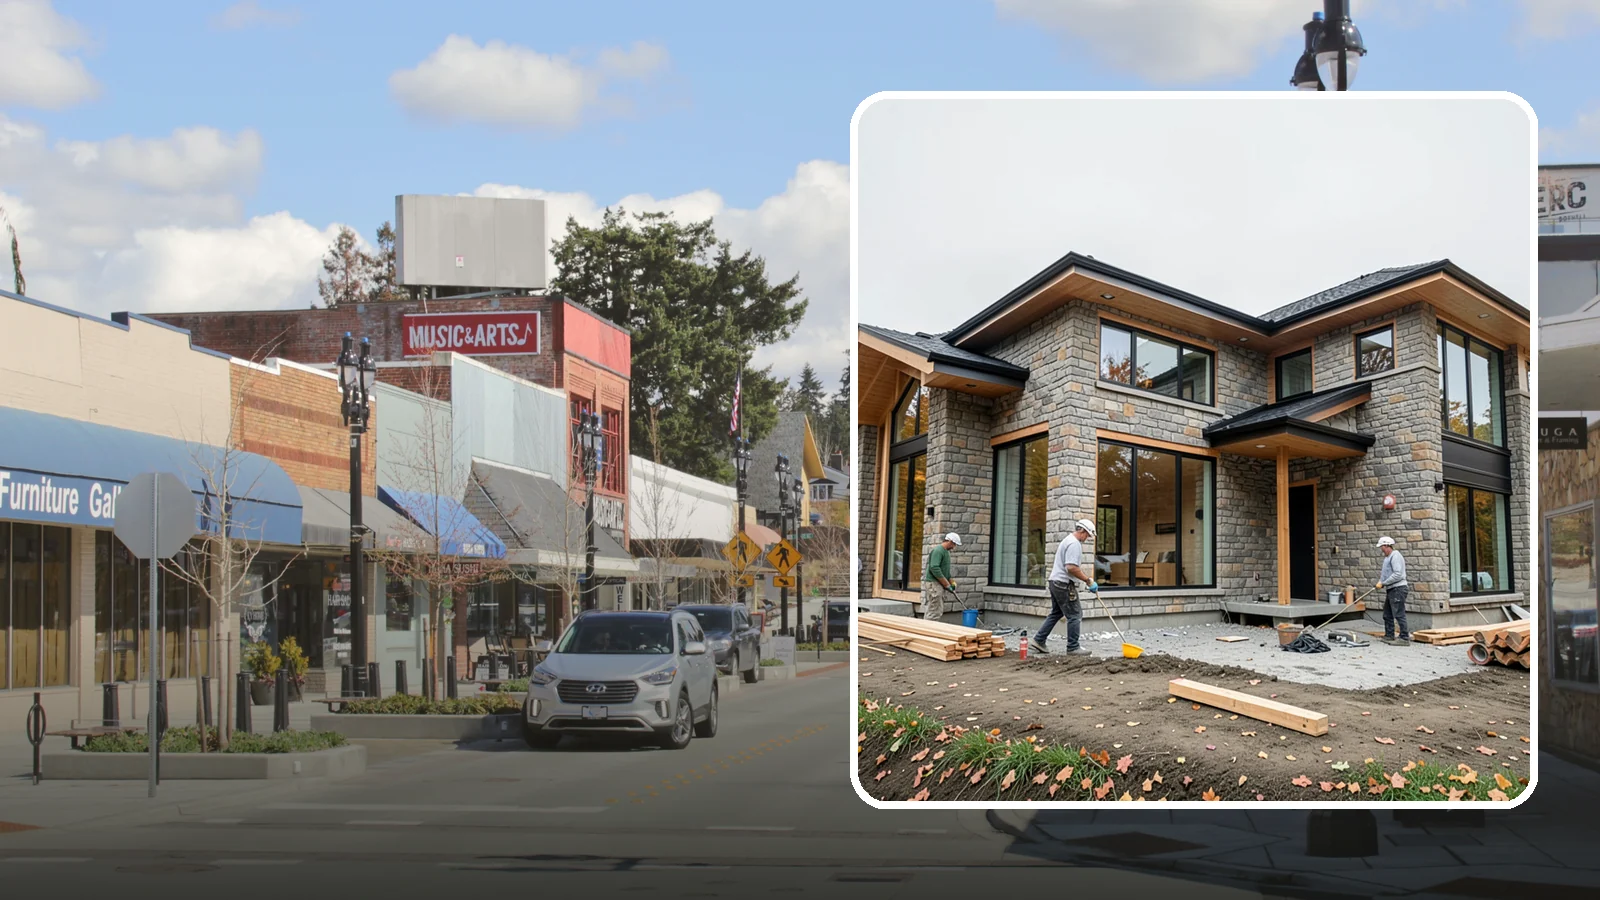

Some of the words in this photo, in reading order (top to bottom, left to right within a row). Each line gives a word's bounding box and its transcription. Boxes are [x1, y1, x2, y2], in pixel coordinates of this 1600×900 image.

[409, 323, 519, 348] MUSIC&ARTS
[0, 472, 79, 515] Furniture
[89, 483, 121, 518] Gal
[454, 563, 479, 574] SUSHI
